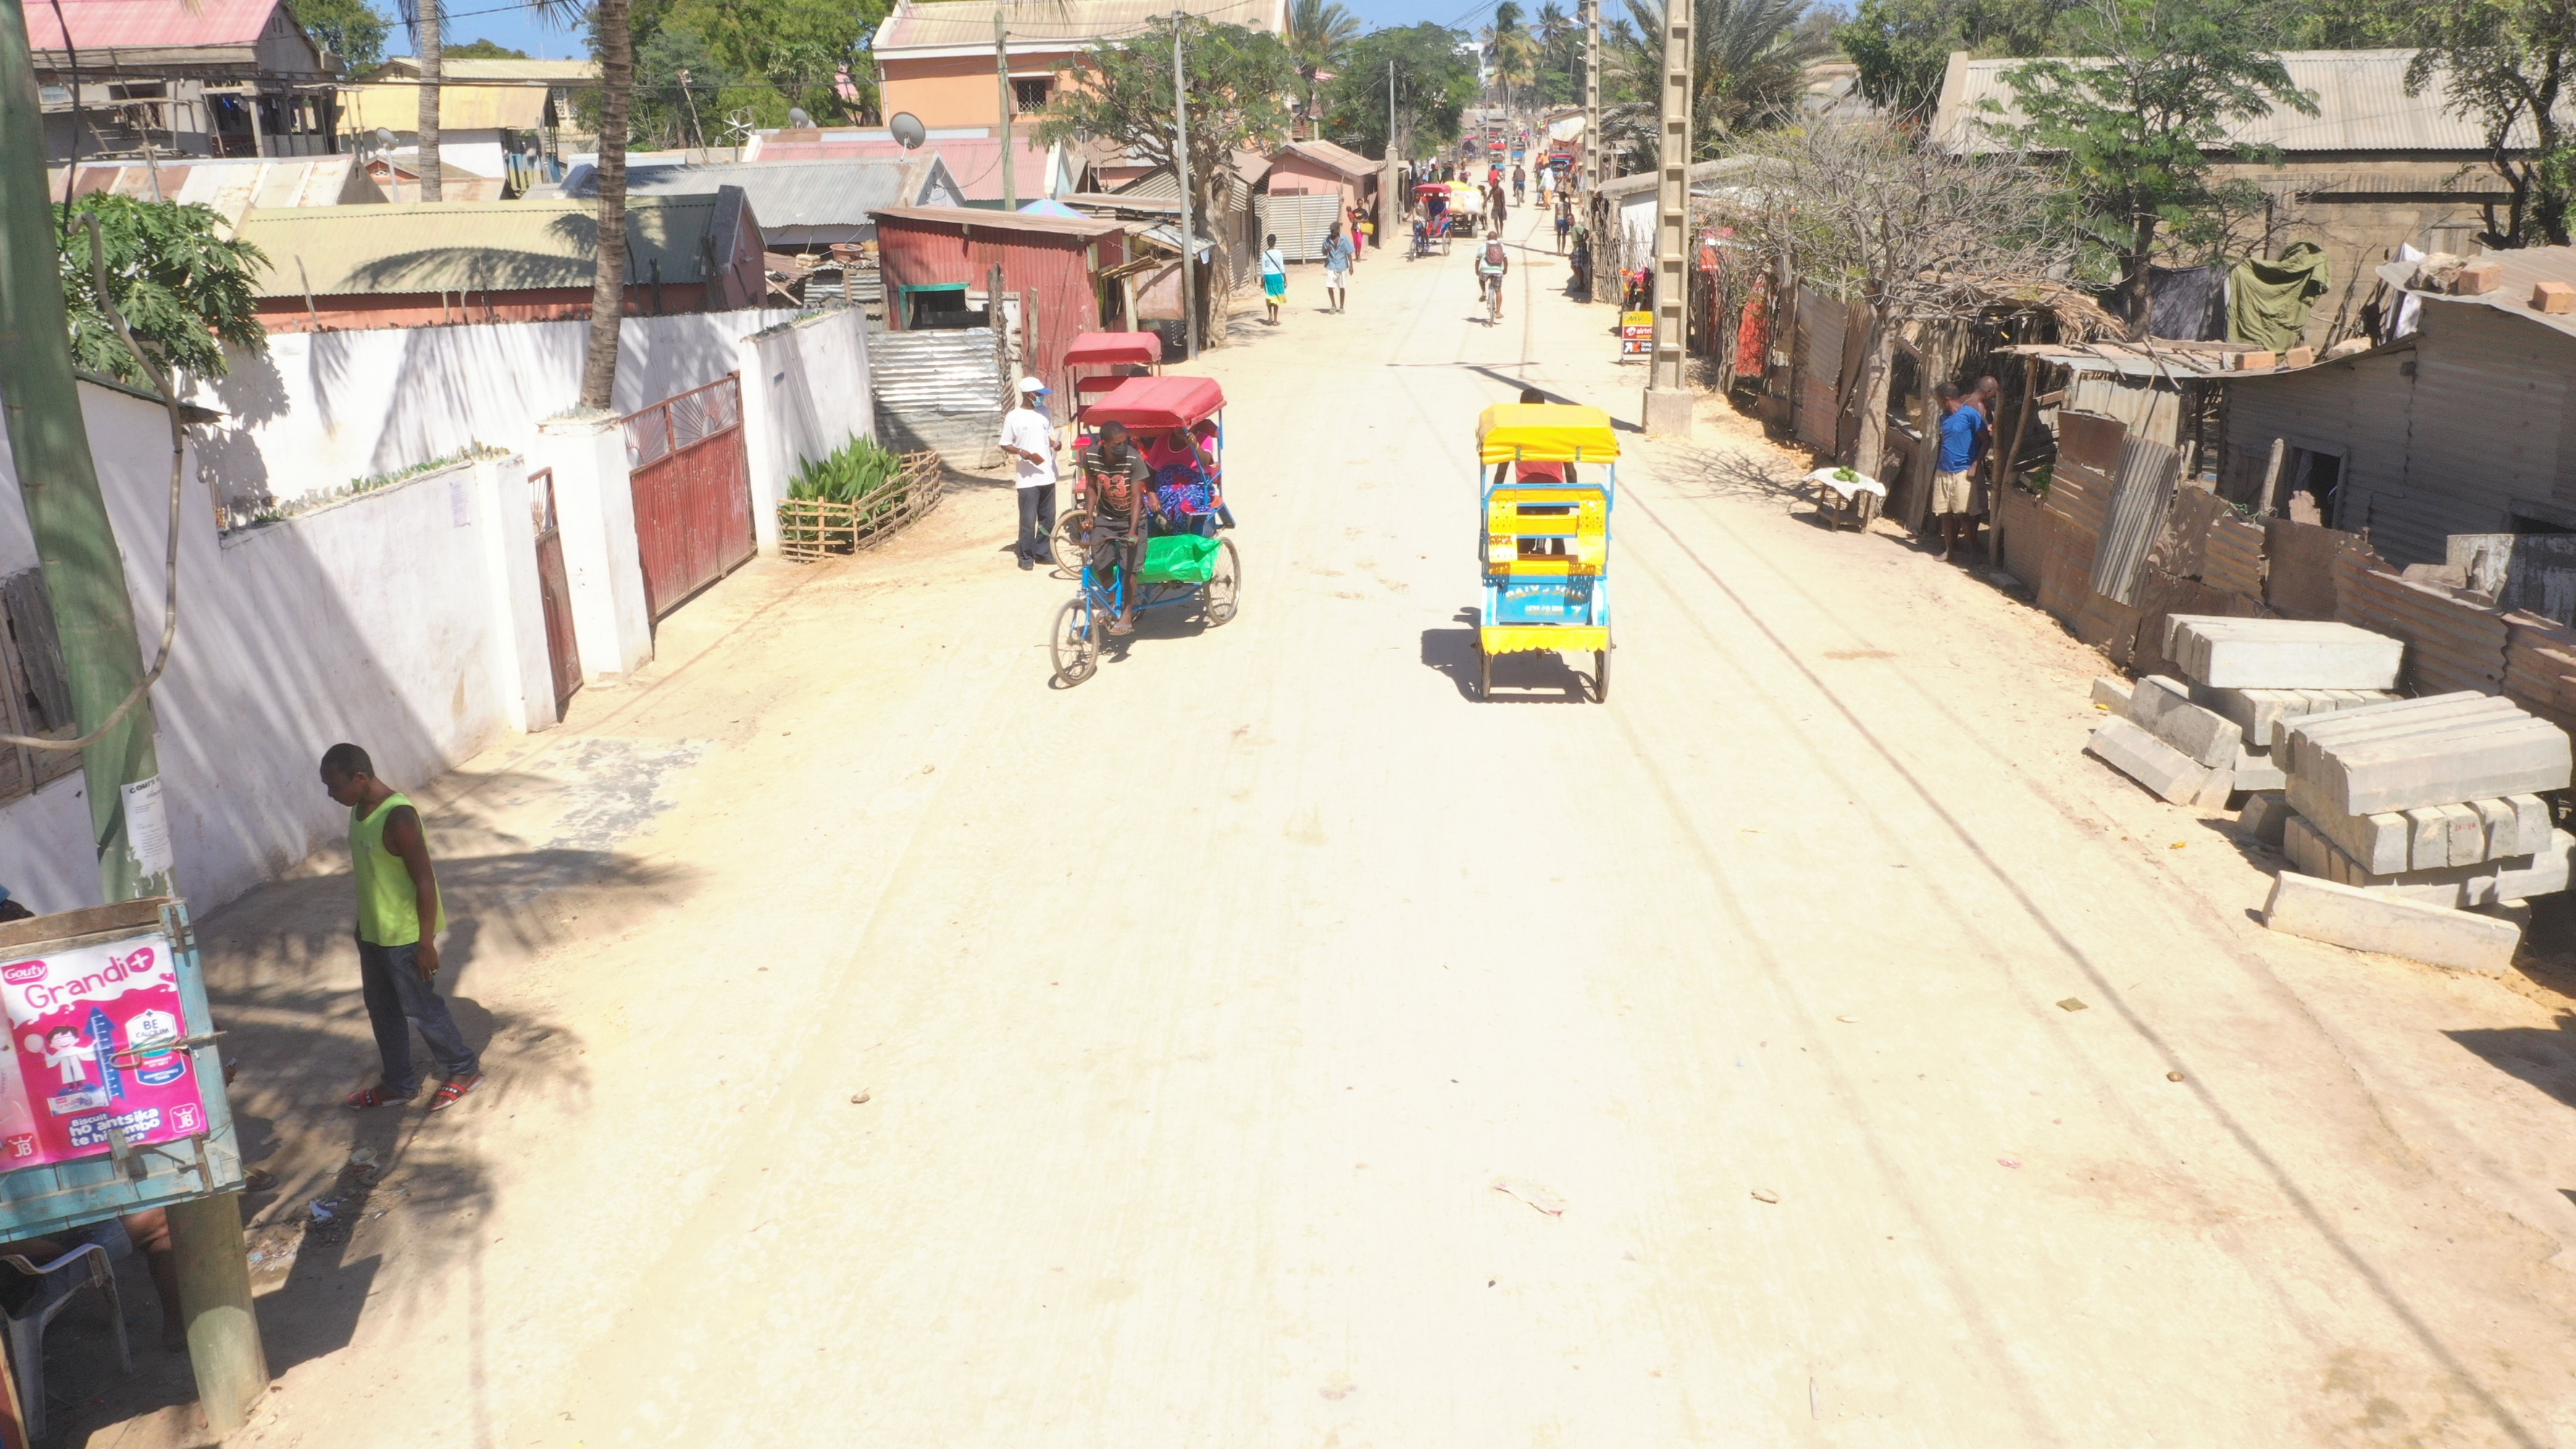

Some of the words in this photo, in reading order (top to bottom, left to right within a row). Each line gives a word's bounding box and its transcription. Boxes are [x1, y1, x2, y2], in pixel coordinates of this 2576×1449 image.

[1097, 474, 1127, 498] 23
[1505, 585, 1540, 601] PAIX
[1552, 585, 1585, 602] JOIE
[1571, 606, 1582, 617] 7
[4, 964, 47, 980] Gouty
[143, 1019, 159, 1030] BE
[69, 1124, 92, 1137] ho
[96, 1108, 159, 1131] antsika
[71, 1113, 108, 1127] Biscuit
[178, 1114, 194, 1129] JB
[71, 1137, 90, 1147] te
[14, 1142, 33, 1158] JB
